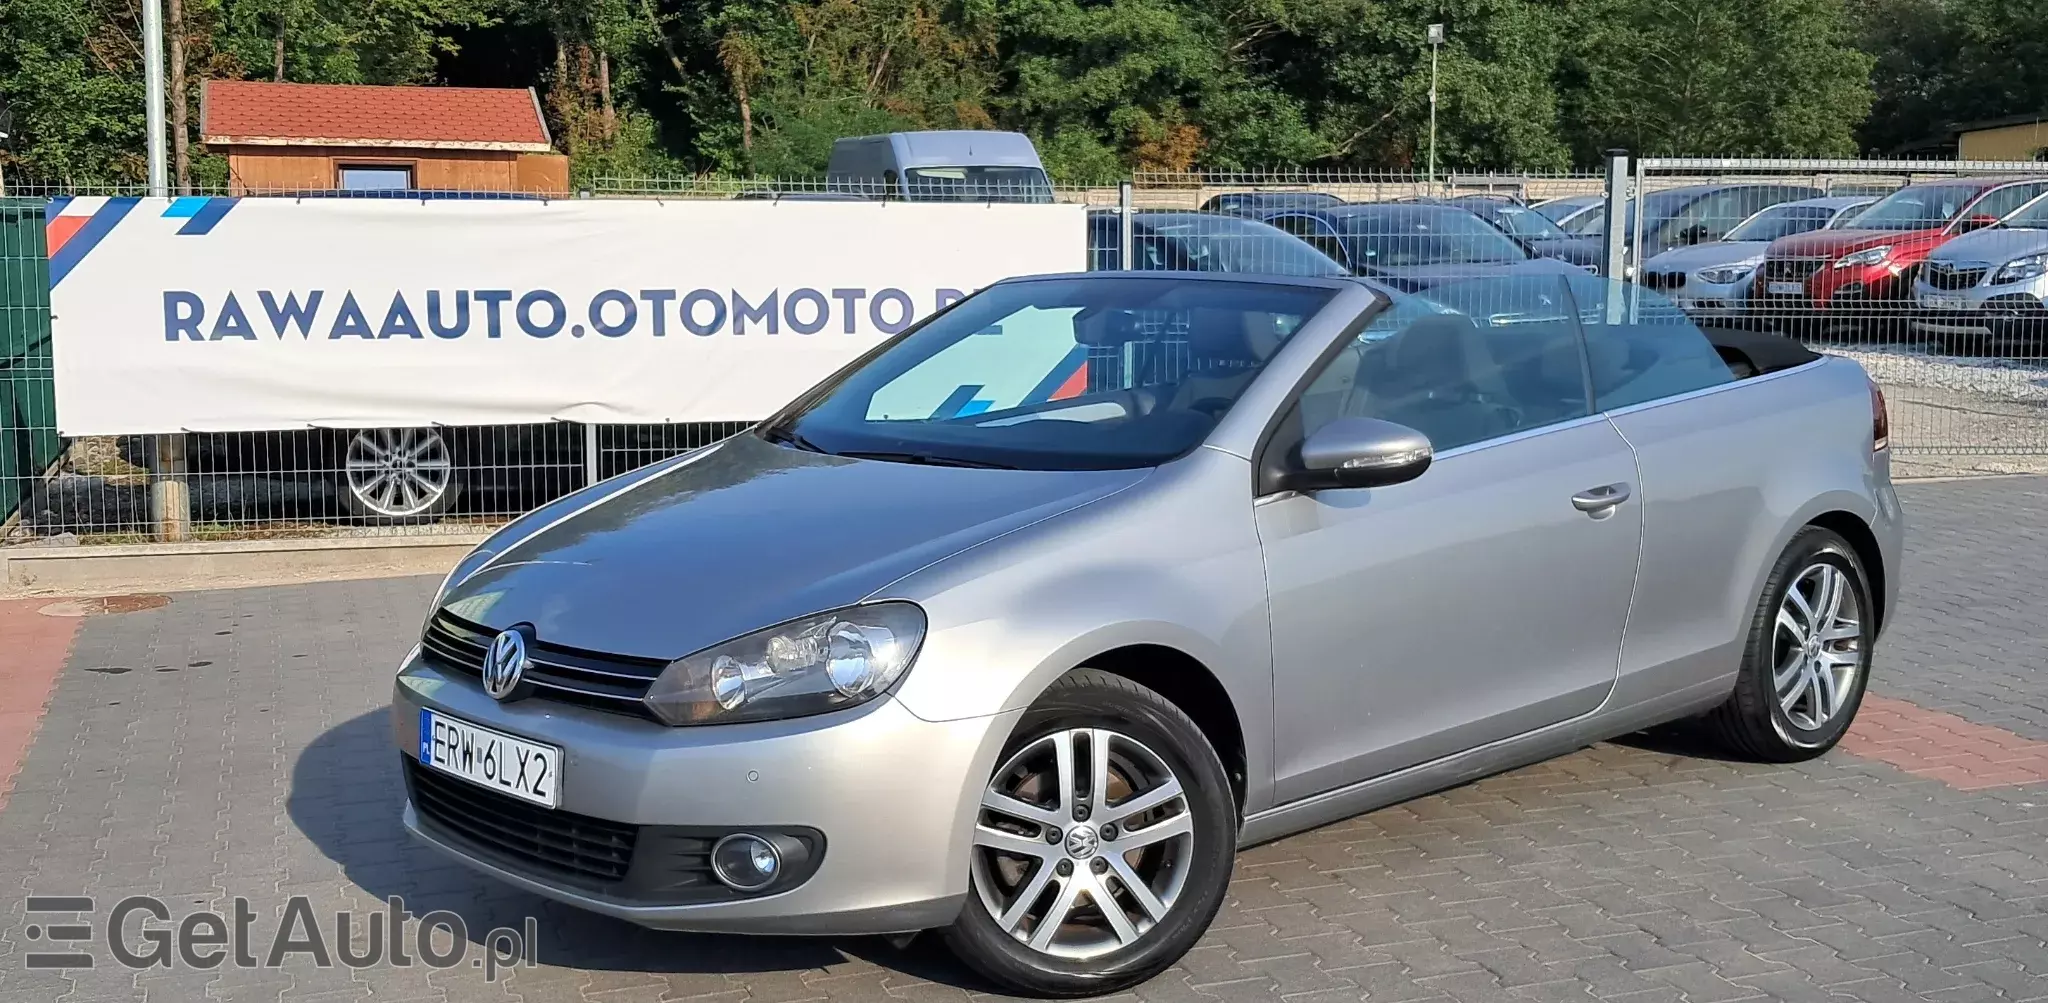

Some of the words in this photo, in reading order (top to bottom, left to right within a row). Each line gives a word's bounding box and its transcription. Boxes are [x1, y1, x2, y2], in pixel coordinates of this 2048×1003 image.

[422, 741, 431, 755] PL
[434, 720, 475, 774] ERW
[484, 740, 547, 798] 6LX2
